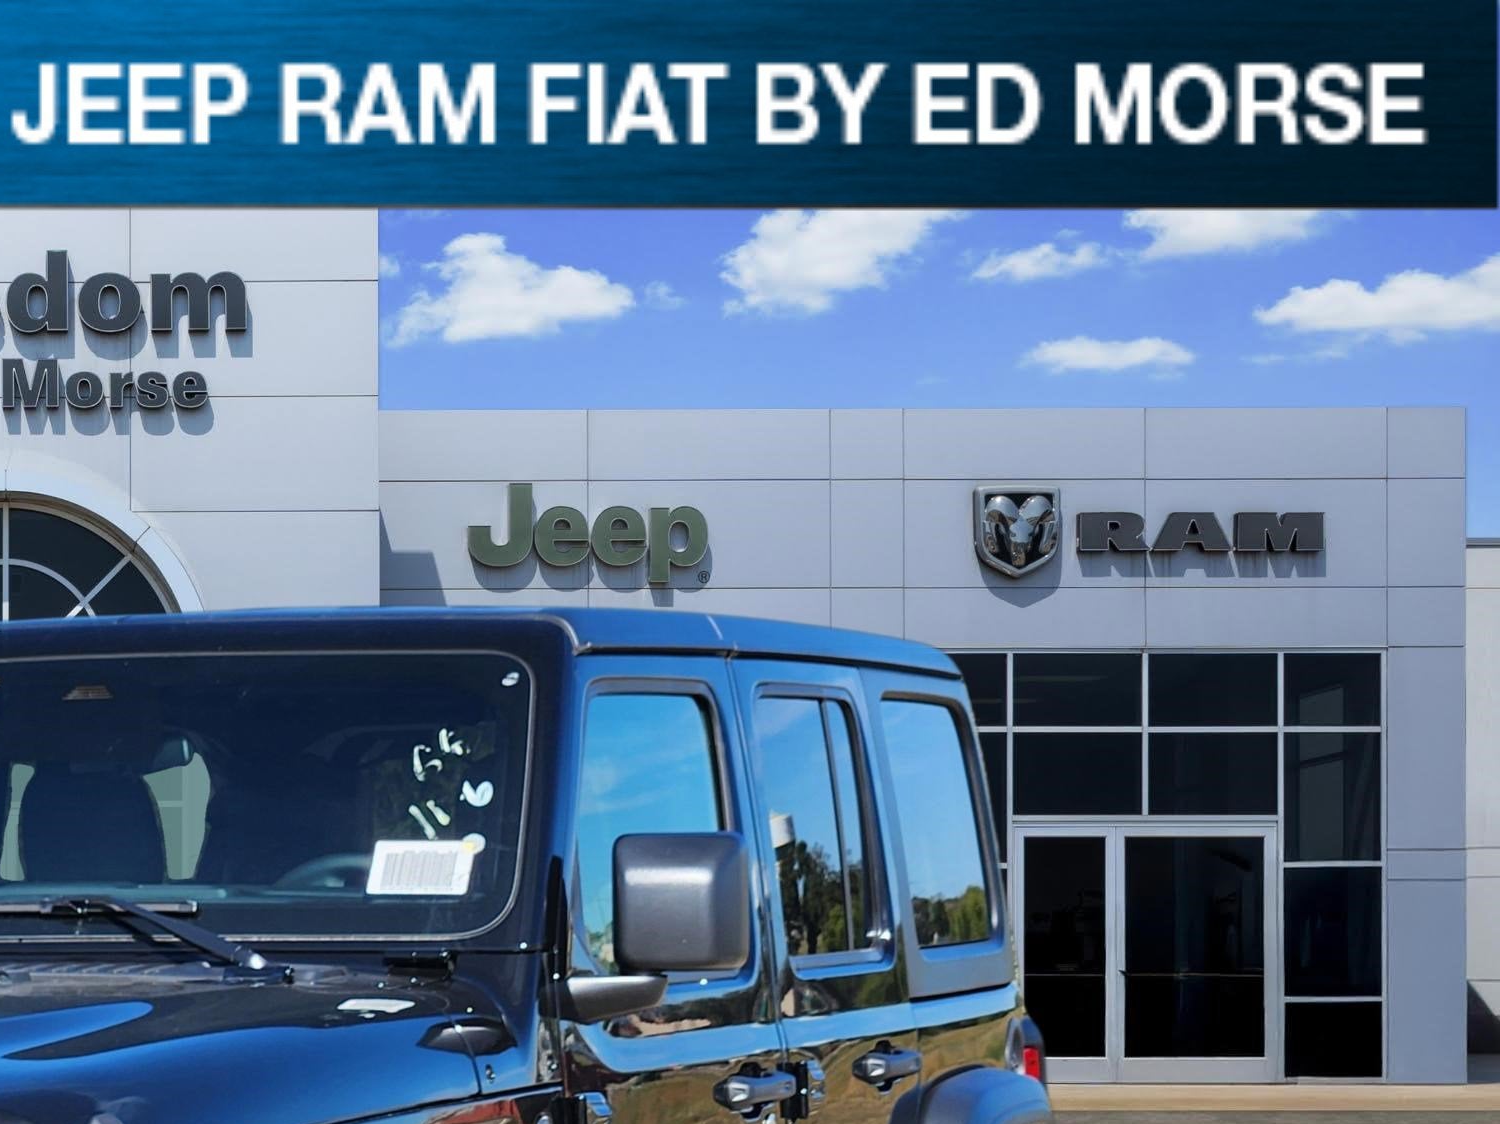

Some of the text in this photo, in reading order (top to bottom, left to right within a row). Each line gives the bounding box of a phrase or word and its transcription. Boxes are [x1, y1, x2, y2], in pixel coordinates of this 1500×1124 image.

[2, 358, 209, 409] Morse
[467, 483, 709, 583] Jeep
[1076, 511, 1325, 552] RAM
